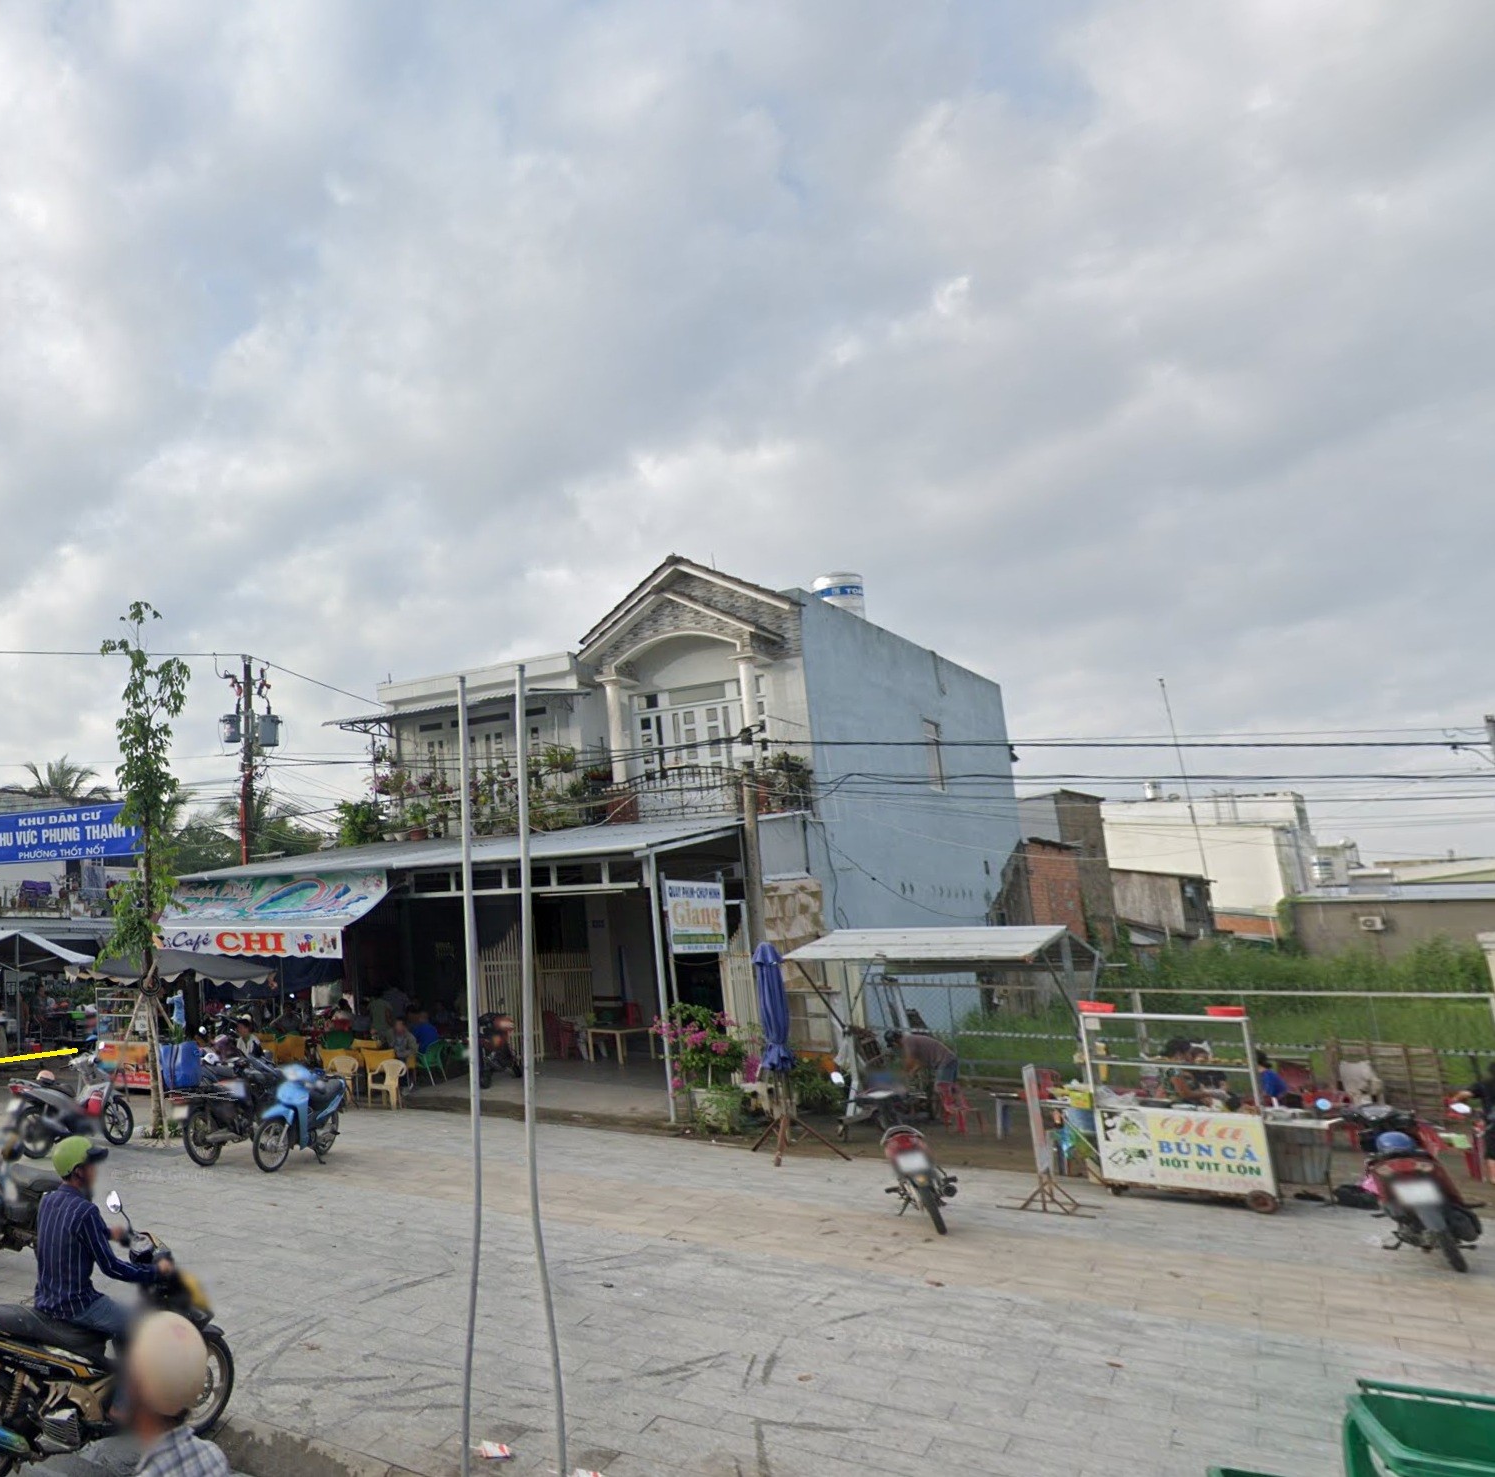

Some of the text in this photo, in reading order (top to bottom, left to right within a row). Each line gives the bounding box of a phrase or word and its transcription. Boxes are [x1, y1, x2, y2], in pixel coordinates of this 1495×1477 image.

[18, 816, 45, 827] KHU
[81, 810, 102, 821] CƯ
[16, 829, 38, 848] VỰC
[42, 827, 81, 845] PHỤNG
[85, 823, 126, 842] THẠNH
[18, 843, 105, 860] PHƯỜNG THỐT NỐT
[672, 900, 722, 932] Giang
[172, 931, 287, 954] Café CHI
[1158, 1138, 1260, 1163] BÚN CÁ
